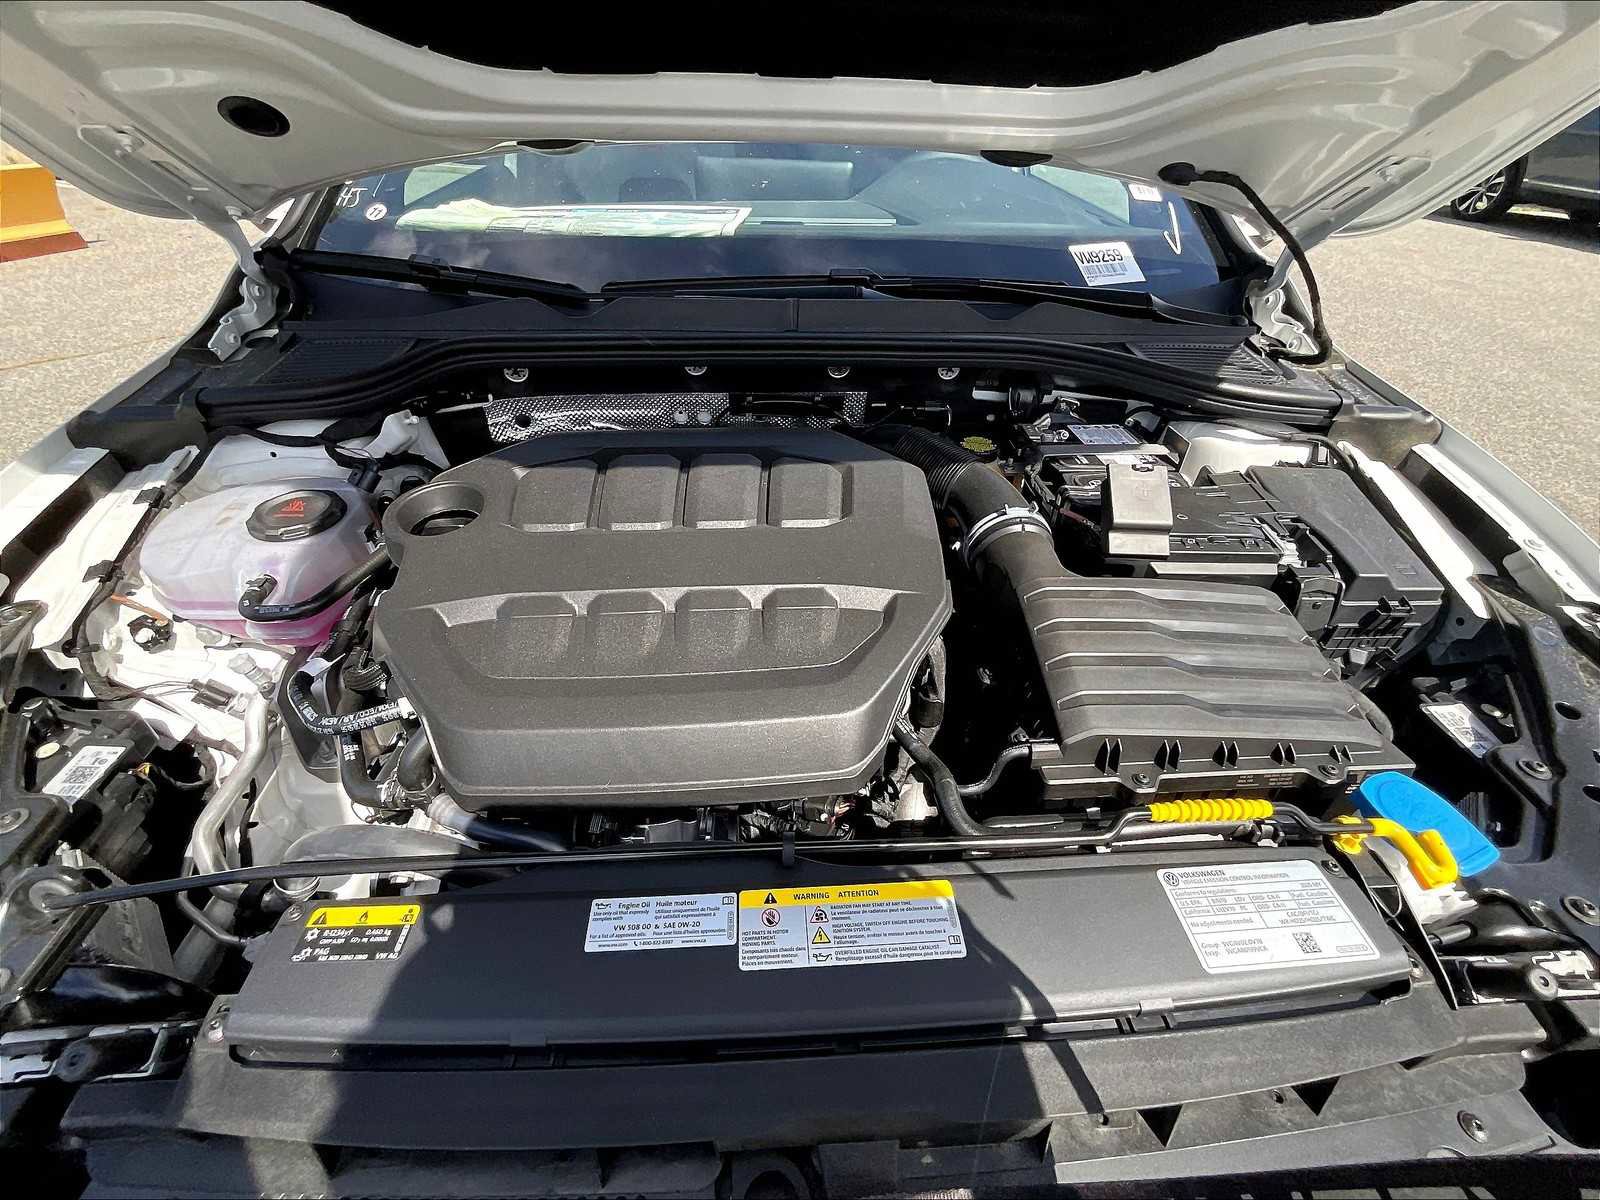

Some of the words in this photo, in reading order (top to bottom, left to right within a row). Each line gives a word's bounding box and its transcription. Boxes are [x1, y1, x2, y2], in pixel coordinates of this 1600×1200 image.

[1074, 248, 1124, 264] VW9259
[1178, 870, 1226, 878] VOLKSWAGEN
[794, 892, 830, 900] WARNING
[838, 890, 879, 898] ATTENTION
[618, 902, 640, 910] Engine
[678, 920, 700, 929] 0W-20
